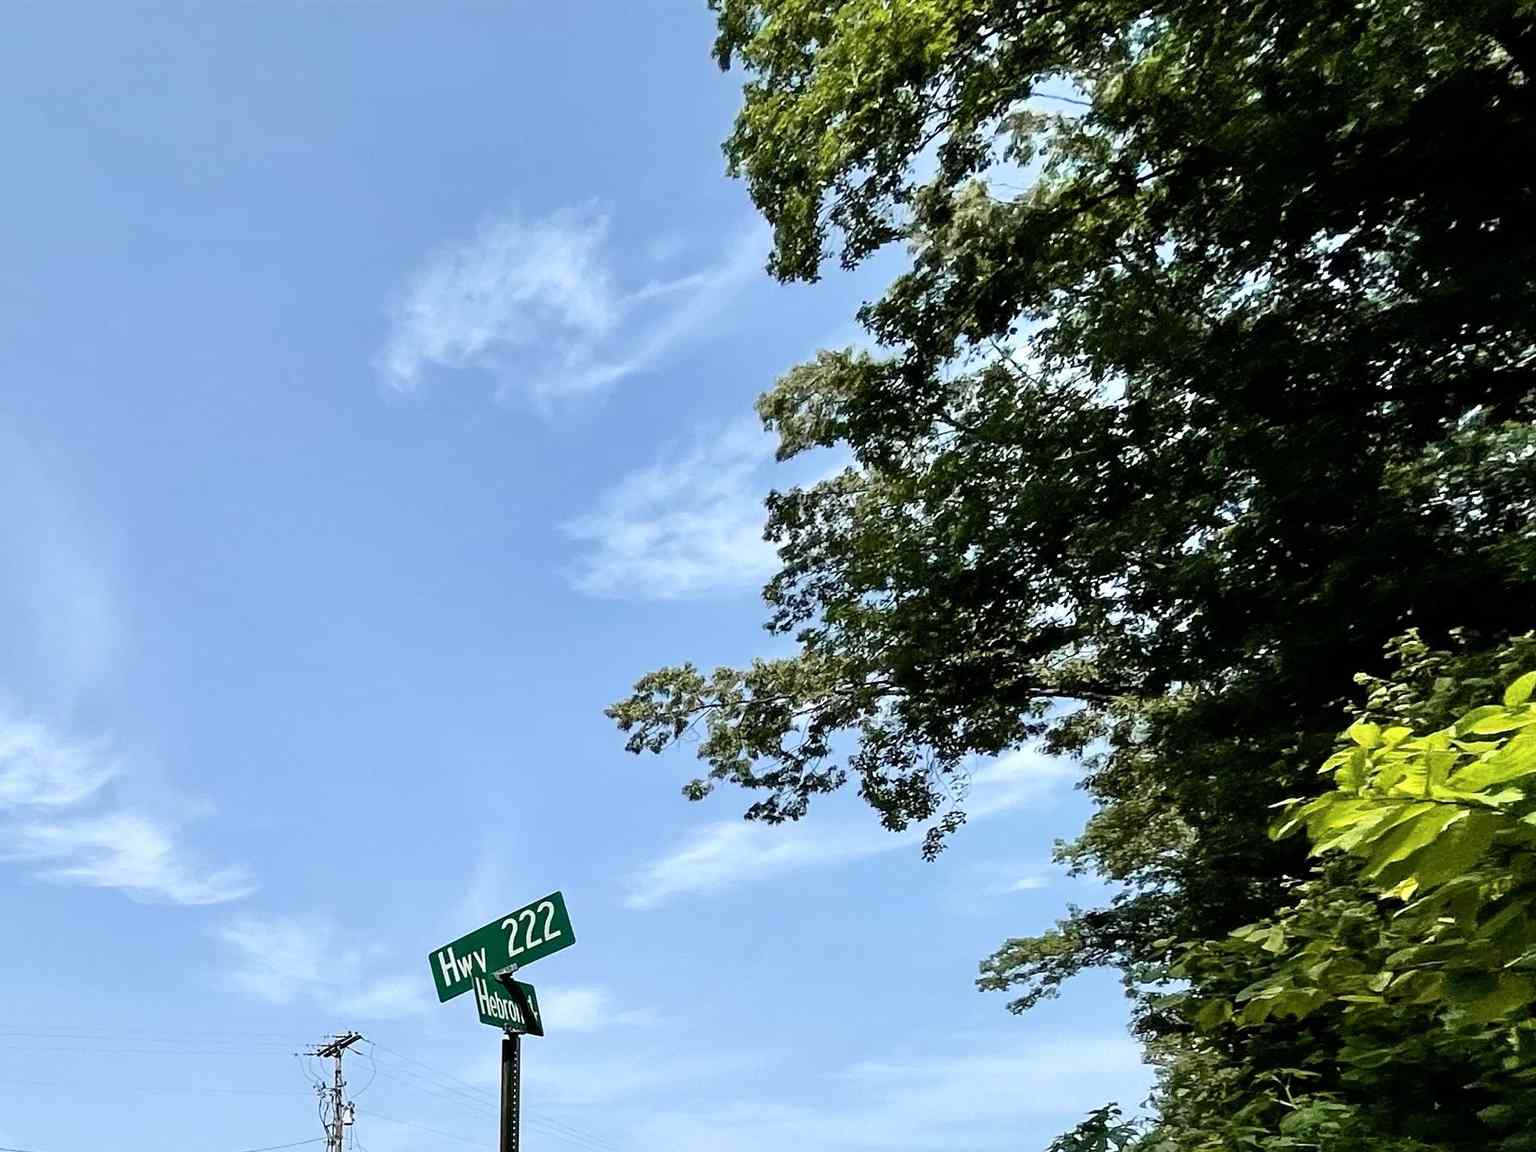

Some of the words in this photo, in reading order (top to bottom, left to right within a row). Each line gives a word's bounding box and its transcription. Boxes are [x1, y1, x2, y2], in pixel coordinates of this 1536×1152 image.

[438, 947, 487, 987] Hwy
[501, 901, 562, 958] 222
[475, 976, 525, 1025] Hebron
